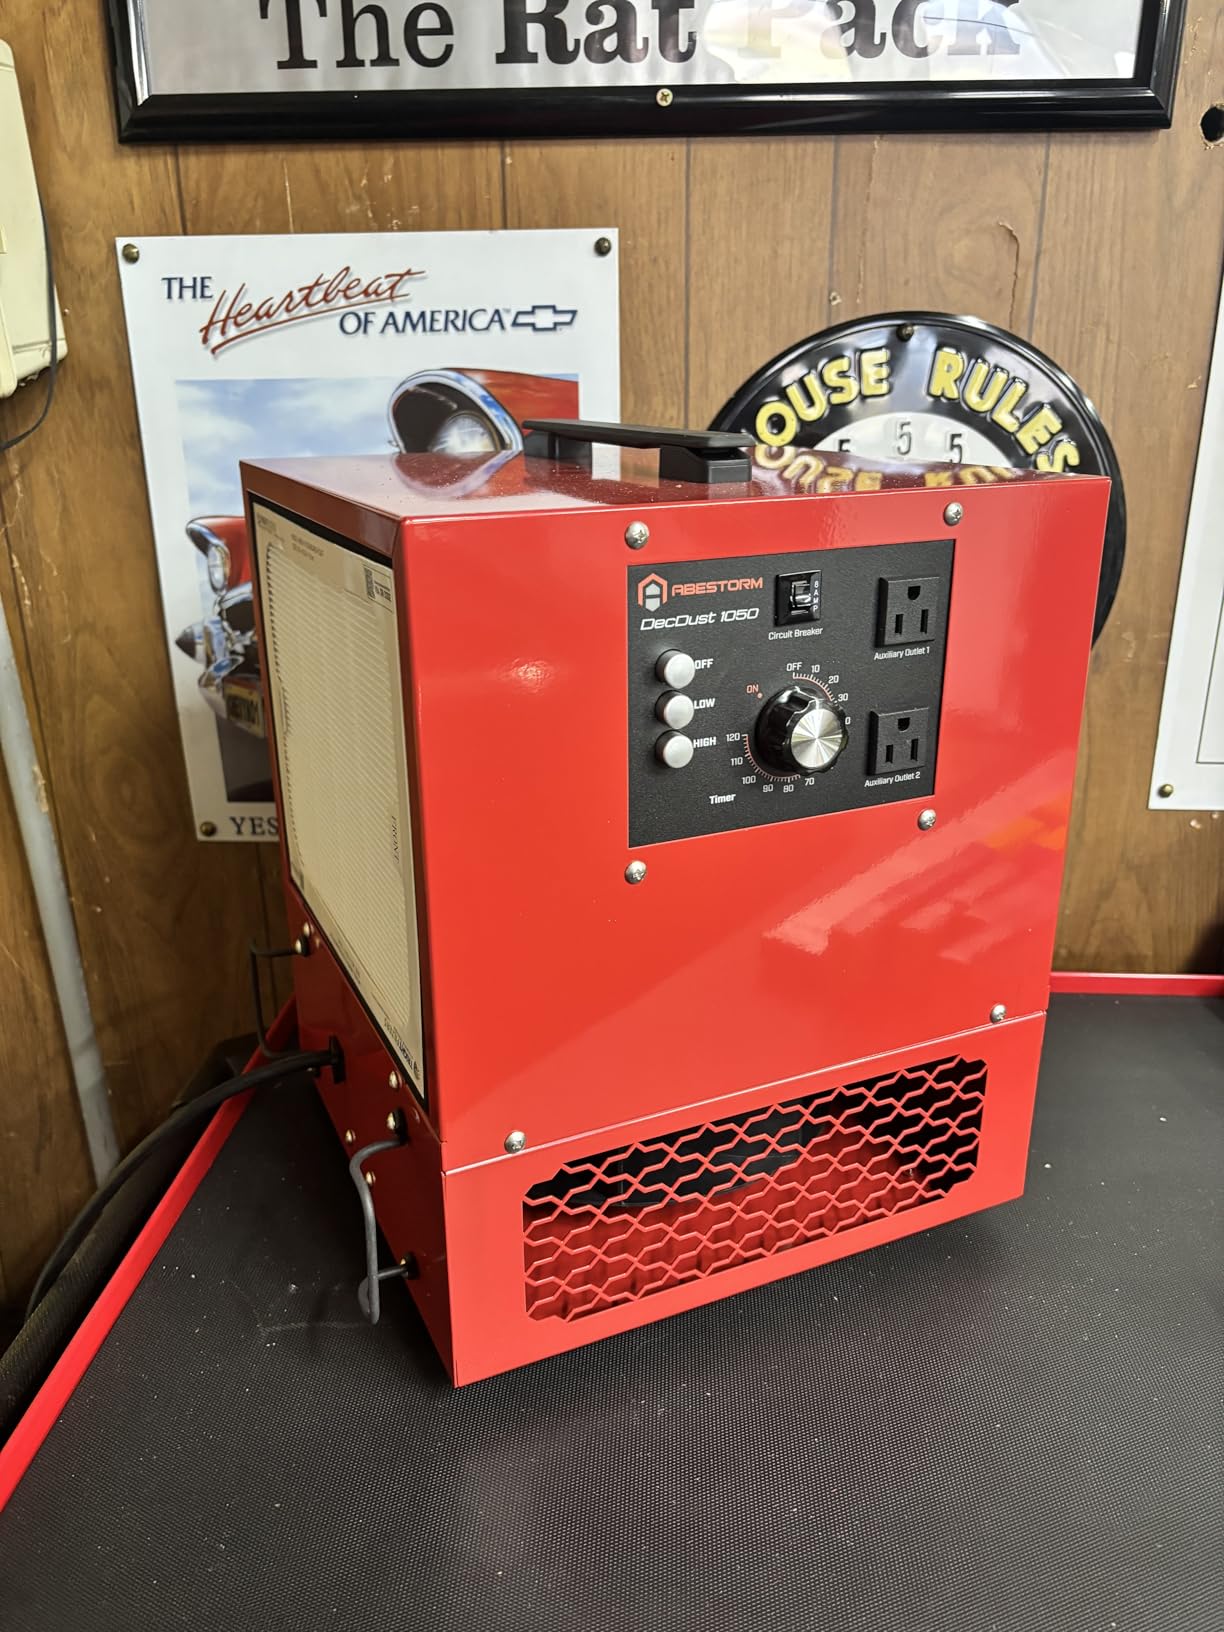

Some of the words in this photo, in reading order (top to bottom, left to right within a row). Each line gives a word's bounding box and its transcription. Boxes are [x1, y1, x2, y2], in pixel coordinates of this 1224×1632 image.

[259, 0, 454, 69] The
[495, 0, 697, 65] Rat
[161, 275, 213, 300] THE
[198, 265, 426, 347] Heartbeat
[339, 310, 376, 335] OF
[379, 308, 506, 334] AMERICA
[755, 346, 891, 447] OUSE
[926, 345, 1082, 474] RULES
[896, 420, 912, 456] 5
[671, 576, 764, 597] ABESTORM
[639, 611, 717, 631] DecDust
[720, 607, 760, 623] 1050
[767, 629, 794, 641] Circuit
[794, 626, 824, 639] Breaker
[873, 650, 904, 661] Auxiliary
[904, 647, 926, 657] Outlet
[694, 658, 714, 670] OFF
[786, 661, 803, 672] OFF
[811, 664, 821, 673] 10
[828, 674, 840, 684] 20
[746, 684, 759, 694] ON
[838, 692, 849, 702] 30
[693, 697, 716, 710] LOW
[844, 716, 851, 725] 0
[693, 736, 717, 749] HIGH
[725, 732, 741, 742] 120
[730, 756, 744, 767] 110
[741, 775, 757, 785] 100
[804, 777, 815, 787] 70
[863, 776, 894, 788] Auxiliary
[894, 773, 915, 783] Outlet
[914, 771, 921, 779] 2
[762, 783, 774, 793] 90
[783, 784, 795, 793] 80
[709, 793, 737, 805] Timer
